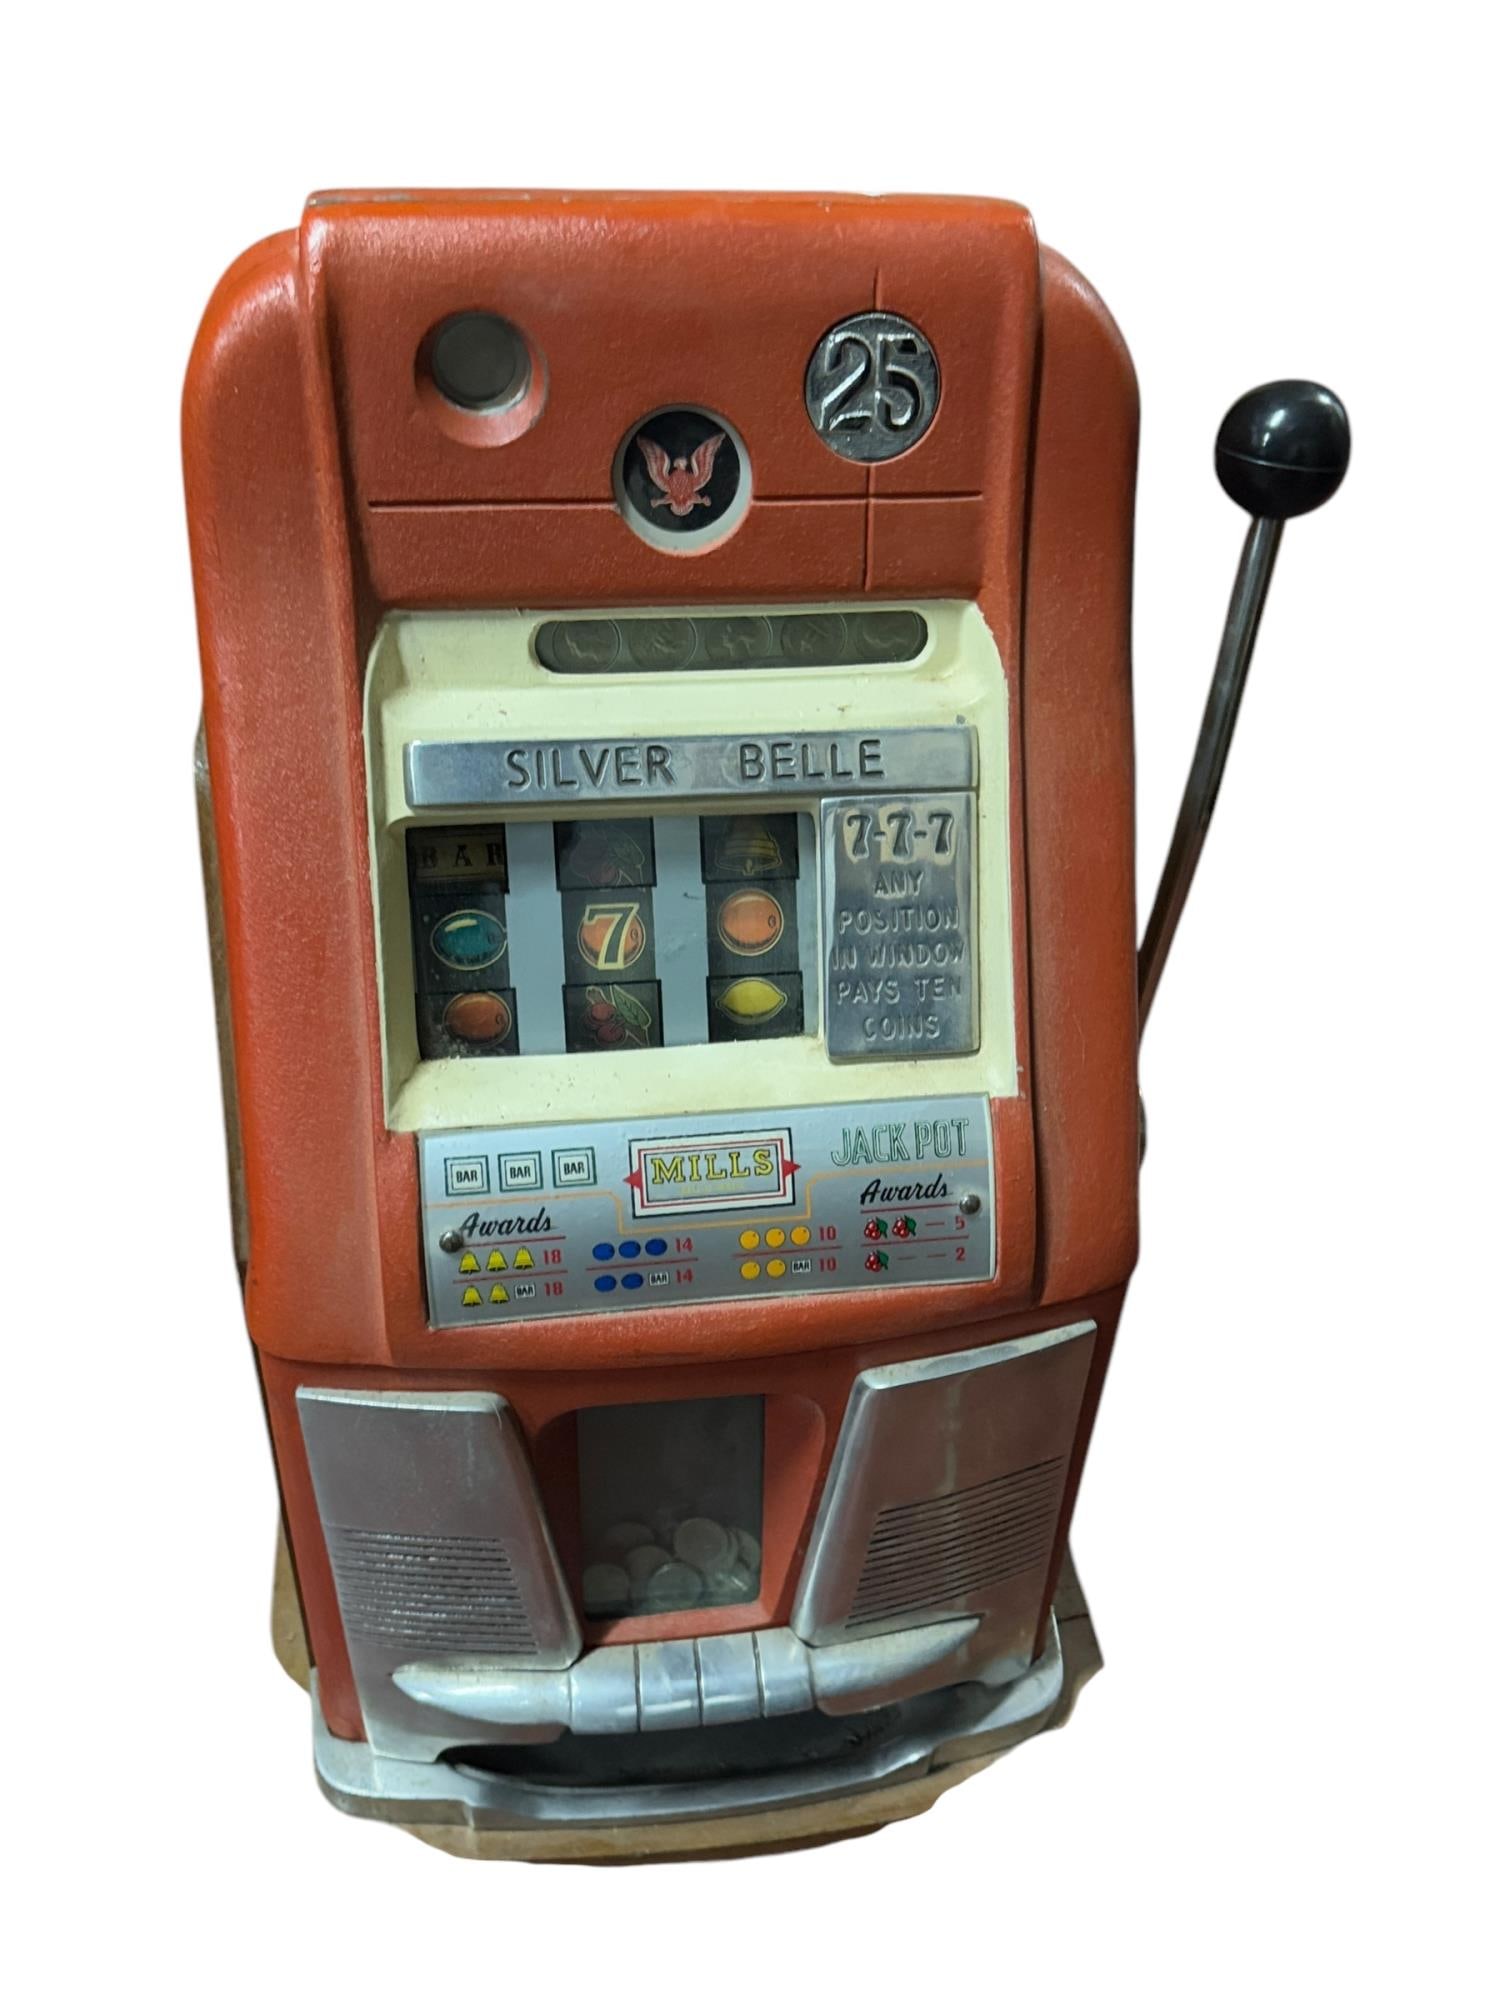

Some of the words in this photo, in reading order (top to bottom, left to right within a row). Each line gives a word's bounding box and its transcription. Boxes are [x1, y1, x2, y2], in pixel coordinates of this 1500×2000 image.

[820, 333, 926, 431] 25
[507, 745, 678, 790] SILVER
[740, 739, 886, 783] BELLE
[847, 814, 954, 858] 7-7-7
[874, 870, 923, 898] ANY
[839, 906, 960, 935] POSITION
[583, 903, 640, 969] 7
[831, 945, 857, 970] IN
[869, 943, 966, 969] WINDOW
[837, 979, 900, 1005] PAYS
[914, 976, 961, 1001] TEN
[863, 1016, 941, 1041] COINS
[831, 1122, 910, 1166] JACK
[914, 1118, 969, 1160] POT
[456, 1170, 478, 1183] BAR
[510, 1165, 531, 1178] BAR
[564, 1161, 585, 1174] BAR
[651, 1148, 774, 1184] MILLS
[860, 1172, 949, 1205] Awards
[460, 1206, 553, 1238] Awards
[819, 1225, 837, 1241] 10
[955, 1215, 966, 1230] 5
[543, 1249, 562, 1265] 18
[675, 1237, 693, 1253] 14
[956, 1247, 966, 1262] 2
[650, 1273, 668, 1284] BAR
[676, 1268, 693, 1284] 14
[793, 1261, 811, 1272] BAR
[819, 1257, 837, 1272] 10
[516, 1285, 534, 1297] BAR
[544, 1281, 563, 1297] 18
